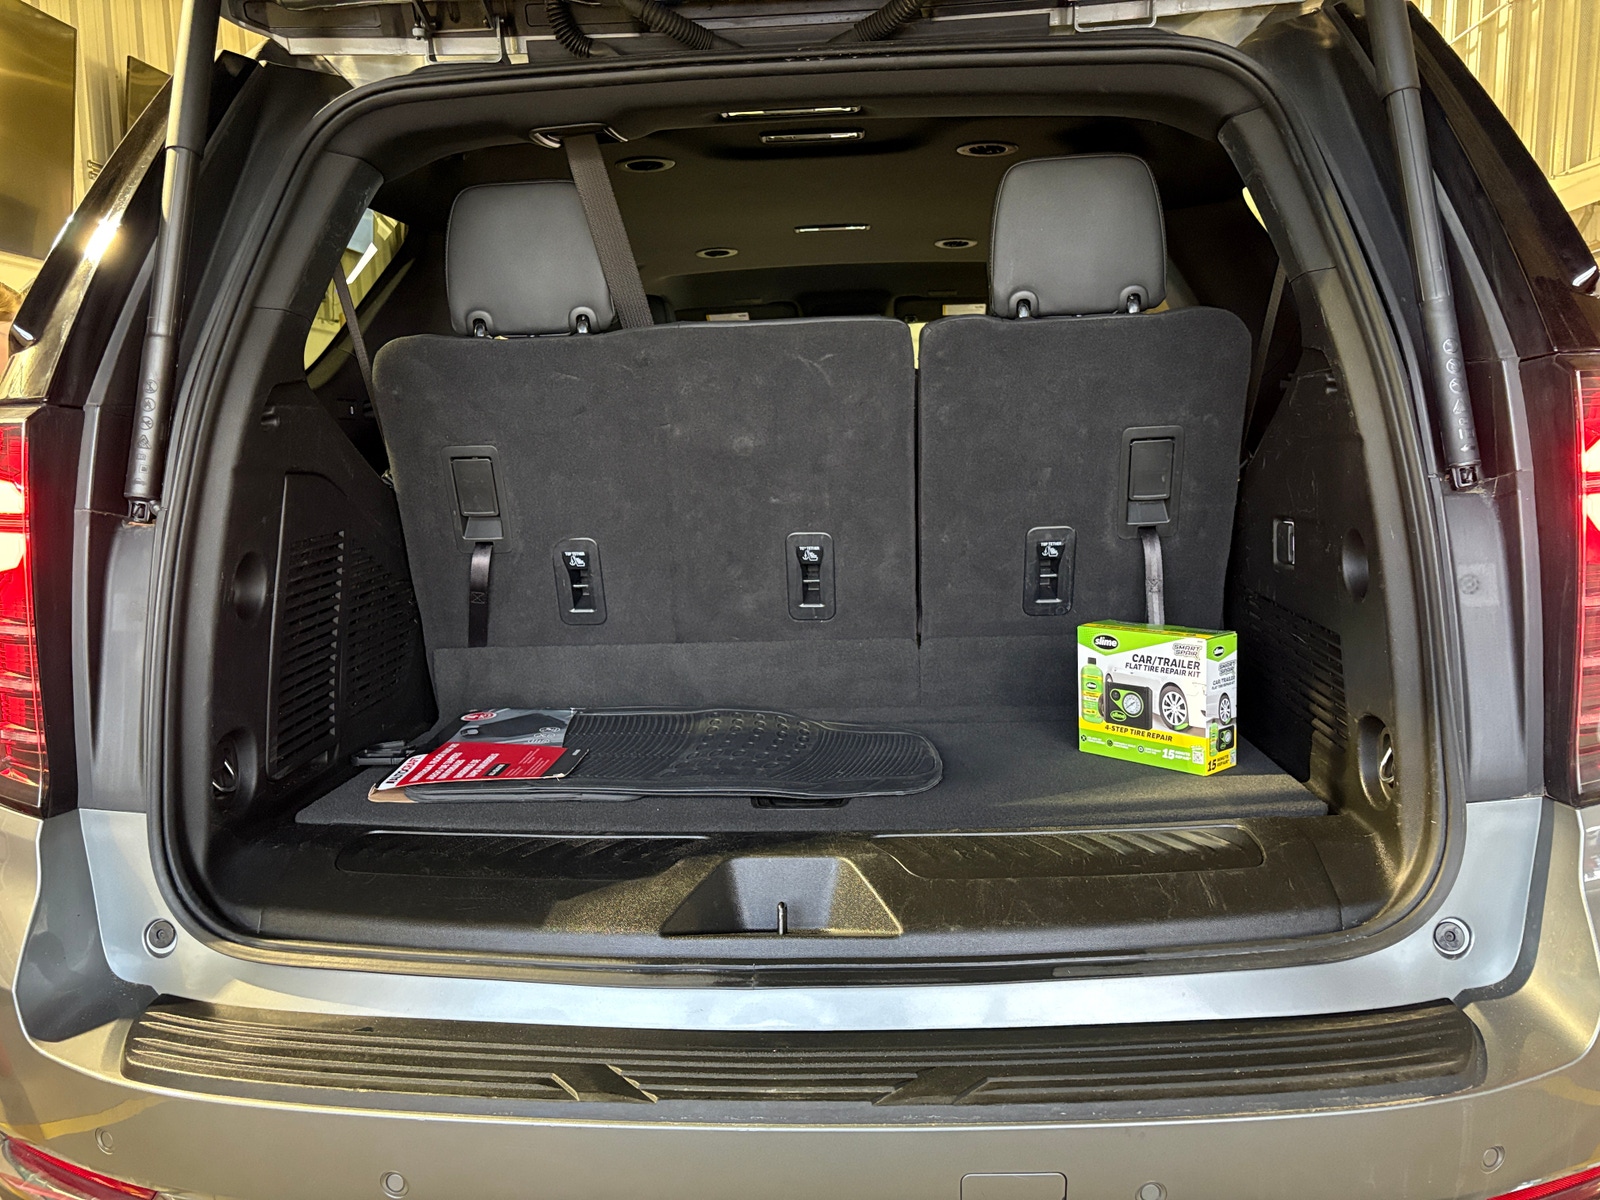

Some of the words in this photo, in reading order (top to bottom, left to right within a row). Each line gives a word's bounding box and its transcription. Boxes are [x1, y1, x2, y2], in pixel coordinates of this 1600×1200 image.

[1094, 636, 1118, 648] slime
[1131, 653, 1201, 671] CAR/TRAILER
[1125, 662, 1142, 670] FLAT
[1143, 664, 1160, 673] TIRE
[1159, 667, 1187, 677] REPAIR
[1104, 724, 1129, 735] 4-STEP
[1130, 728, 1146, 737] TIRE
[1146, 731, 1173, 742] REPAIR
[1162, 748, 1175, 760] 15
[1207, 759, 1216, 772] 15
